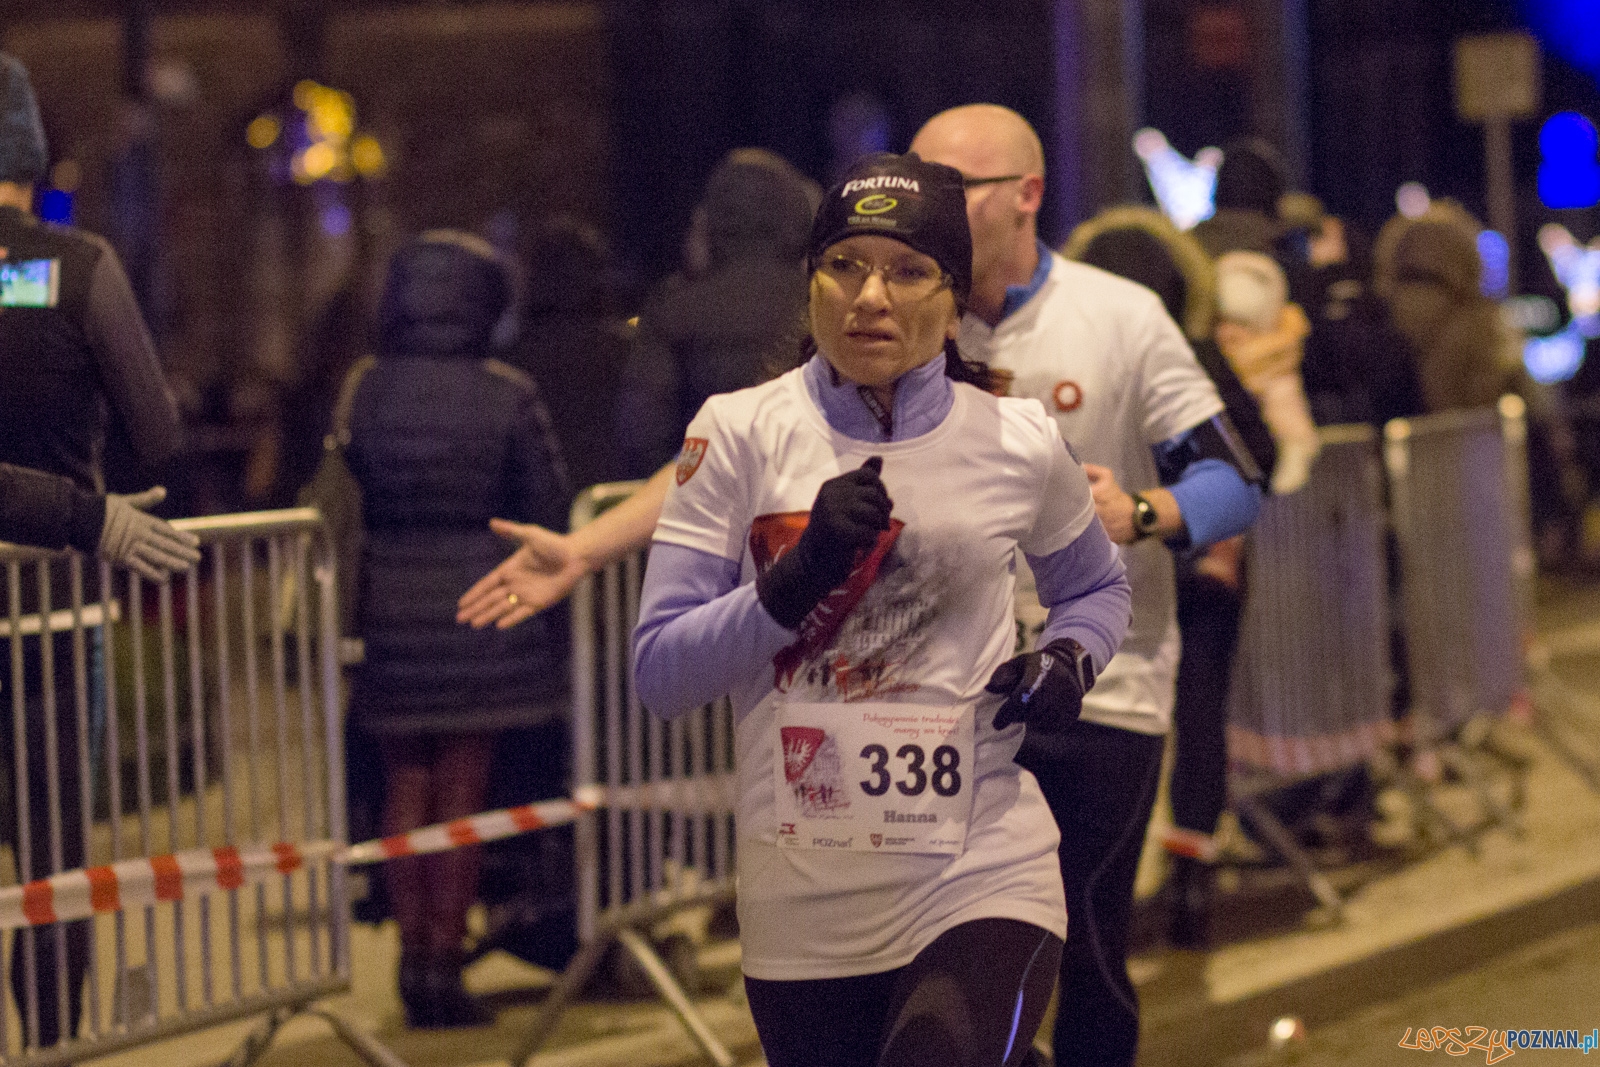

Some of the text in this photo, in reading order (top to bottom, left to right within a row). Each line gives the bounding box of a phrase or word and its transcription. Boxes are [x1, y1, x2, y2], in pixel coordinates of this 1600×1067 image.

[841, 176, 920, 198] FORTUNA
[859, 743, 962, 797] 338
[883, 810, 938, 823] Hanna
